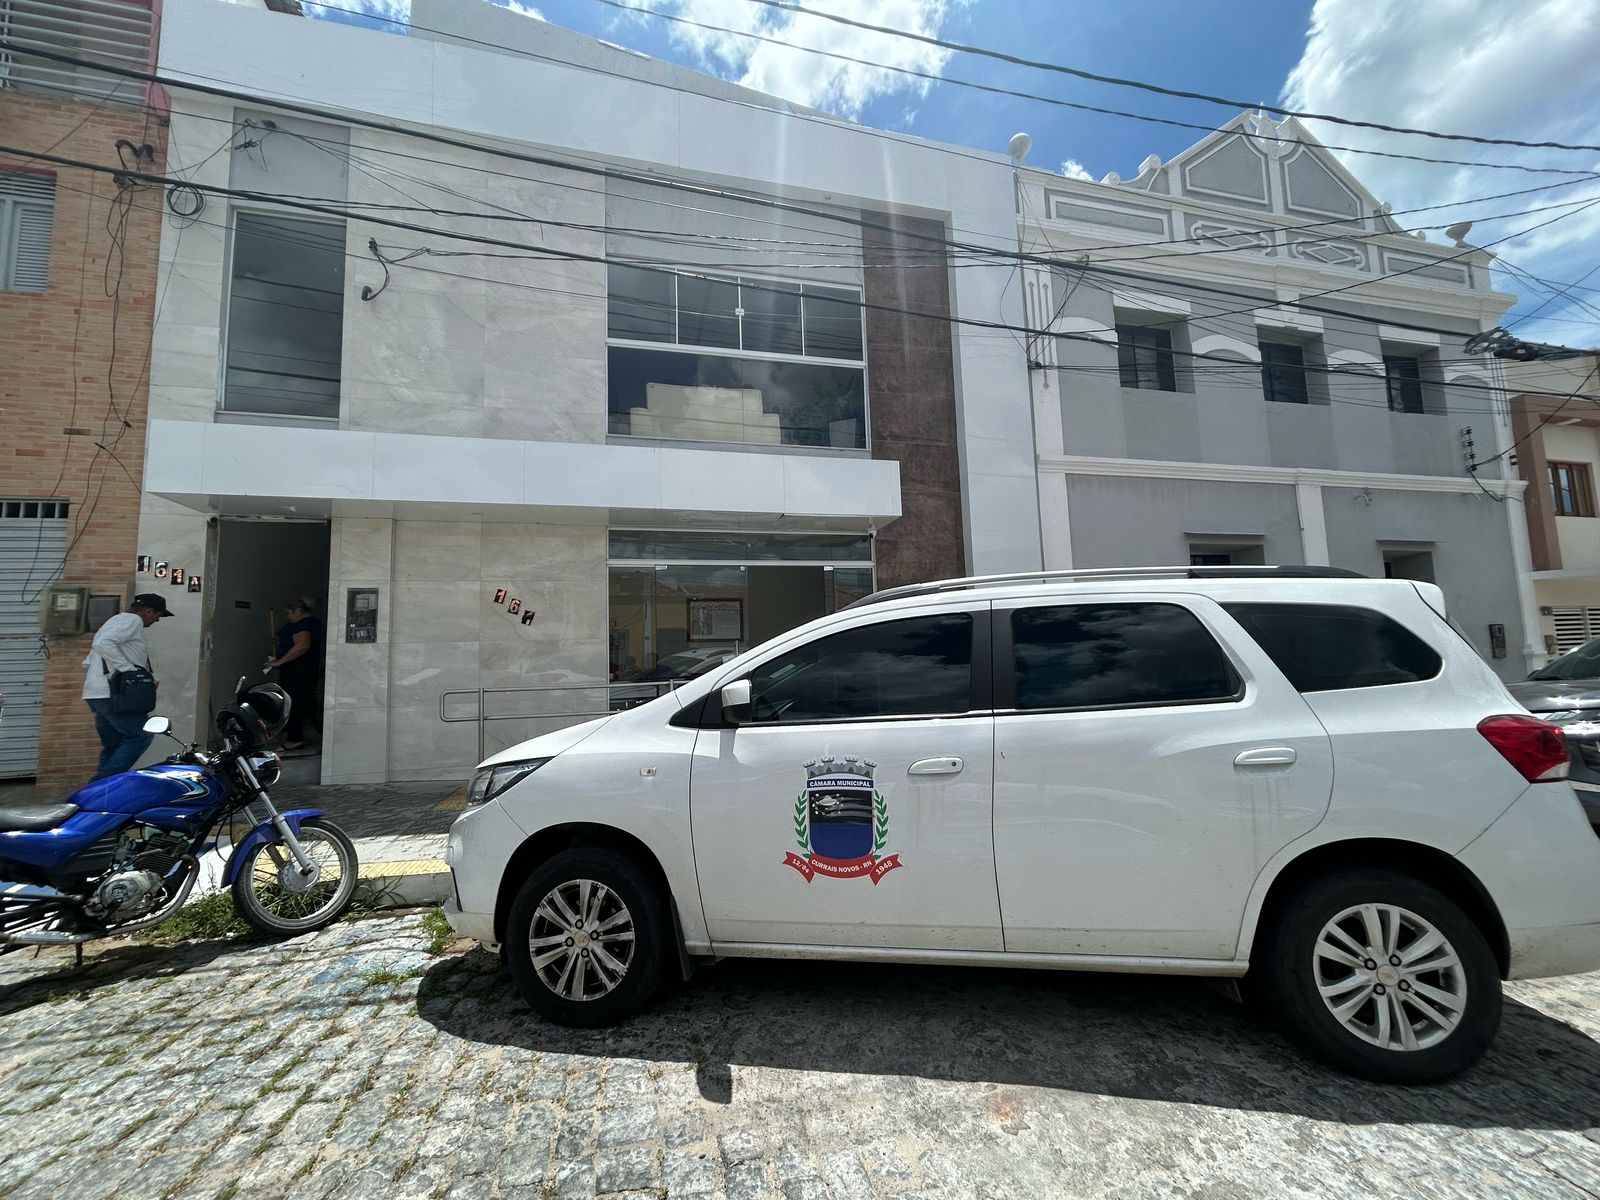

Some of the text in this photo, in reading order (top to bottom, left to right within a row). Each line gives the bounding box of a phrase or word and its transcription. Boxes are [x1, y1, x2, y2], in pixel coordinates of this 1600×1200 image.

[811, 859, 838, 872] CURRAIS
[838, 865, 860, 873] NOVOS
[862, 860, 873, 869] RN
[875, 860, 893, 875] 1948
